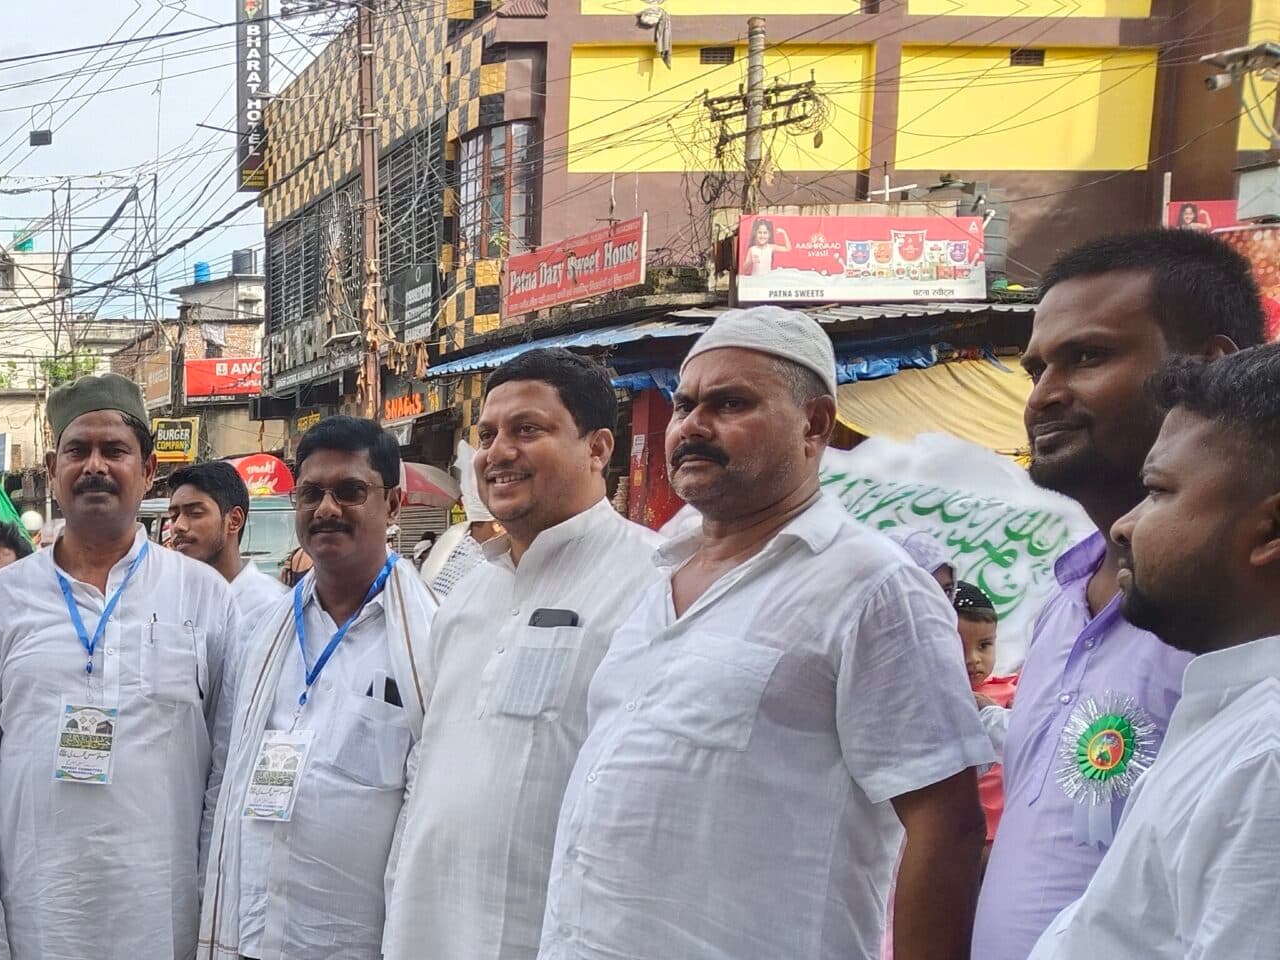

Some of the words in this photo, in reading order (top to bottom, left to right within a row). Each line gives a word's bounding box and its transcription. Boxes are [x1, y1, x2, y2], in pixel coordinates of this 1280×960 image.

[247, 24, 261, 94] BHARAT
[246, 99, 261, 156] HOTEL
[510, 269, 537, 296] Patna
[566, 249, 600, 279] Sweet
[604, 239, 639, 268] House
[769, 290, 792, 298] PATNA
[795, 289, 824, 298] SWEETS
[231, 362, 262, 375] ANC
[157, 429, 190, 441] BURGER
